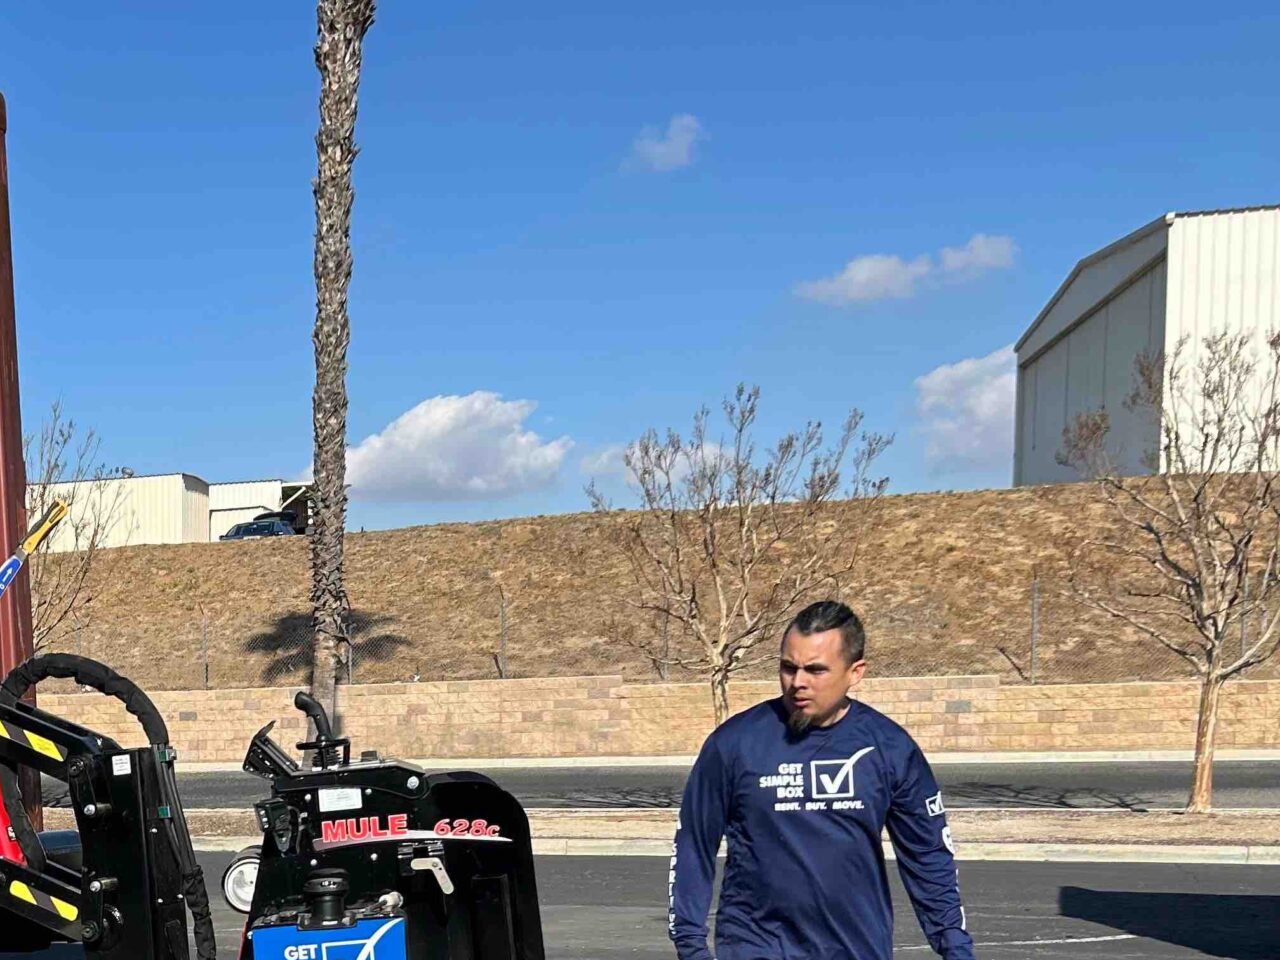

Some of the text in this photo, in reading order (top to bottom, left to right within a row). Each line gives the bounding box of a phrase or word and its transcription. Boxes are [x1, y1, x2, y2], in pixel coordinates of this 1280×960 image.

[778, 763, 803, 775] GET
[759, 774, 804, 788] SIMPLE
[777, 786, 804, 798] BOX
[322, 814, 408, 842] MULE
